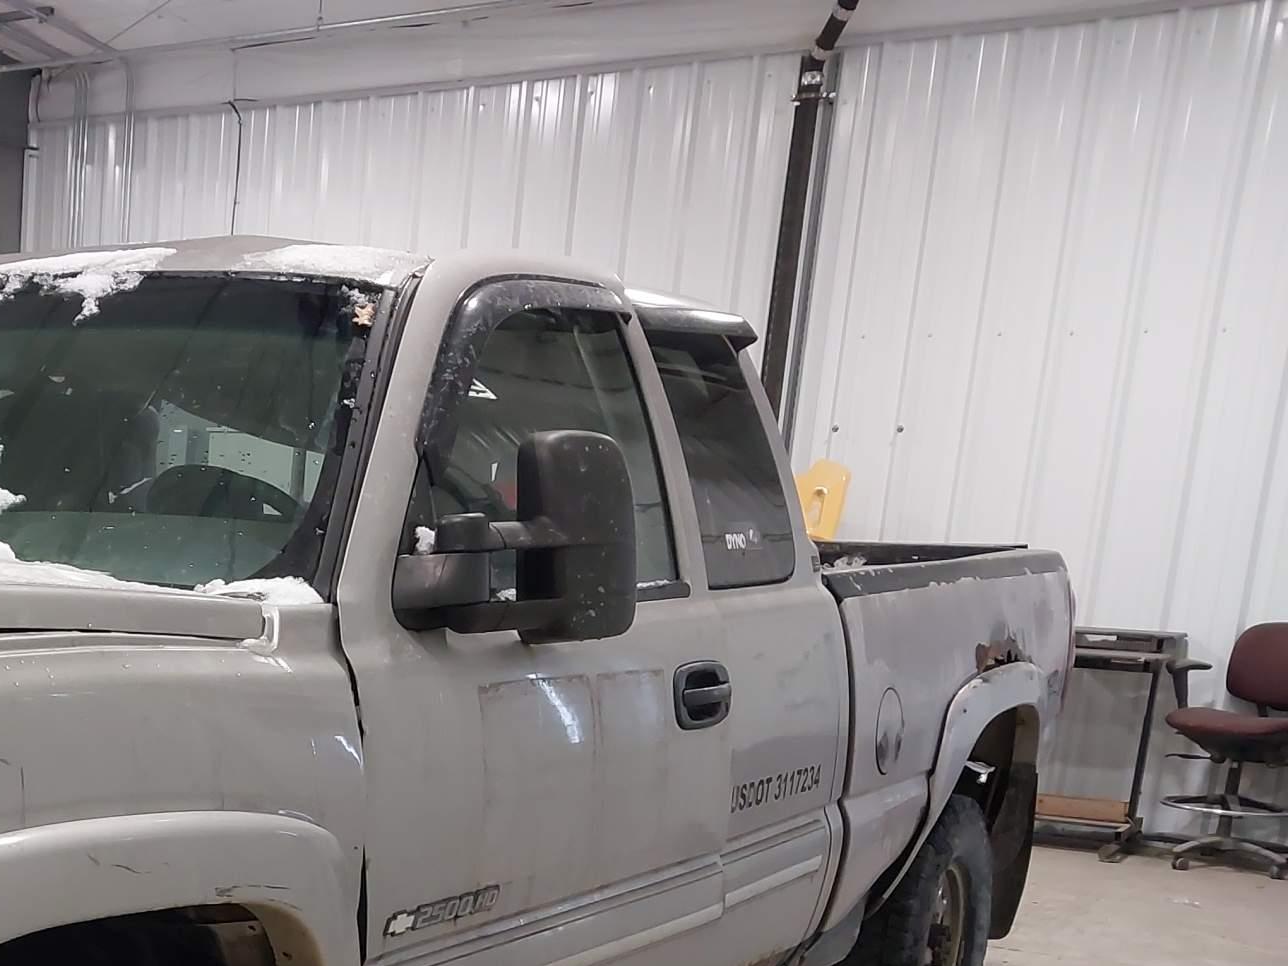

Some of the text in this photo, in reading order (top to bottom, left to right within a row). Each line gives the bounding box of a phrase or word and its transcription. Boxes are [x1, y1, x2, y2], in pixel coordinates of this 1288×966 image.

[731, 764, 821, 814] USDOT 3117234
[415, 893, 475, 930] 2500
